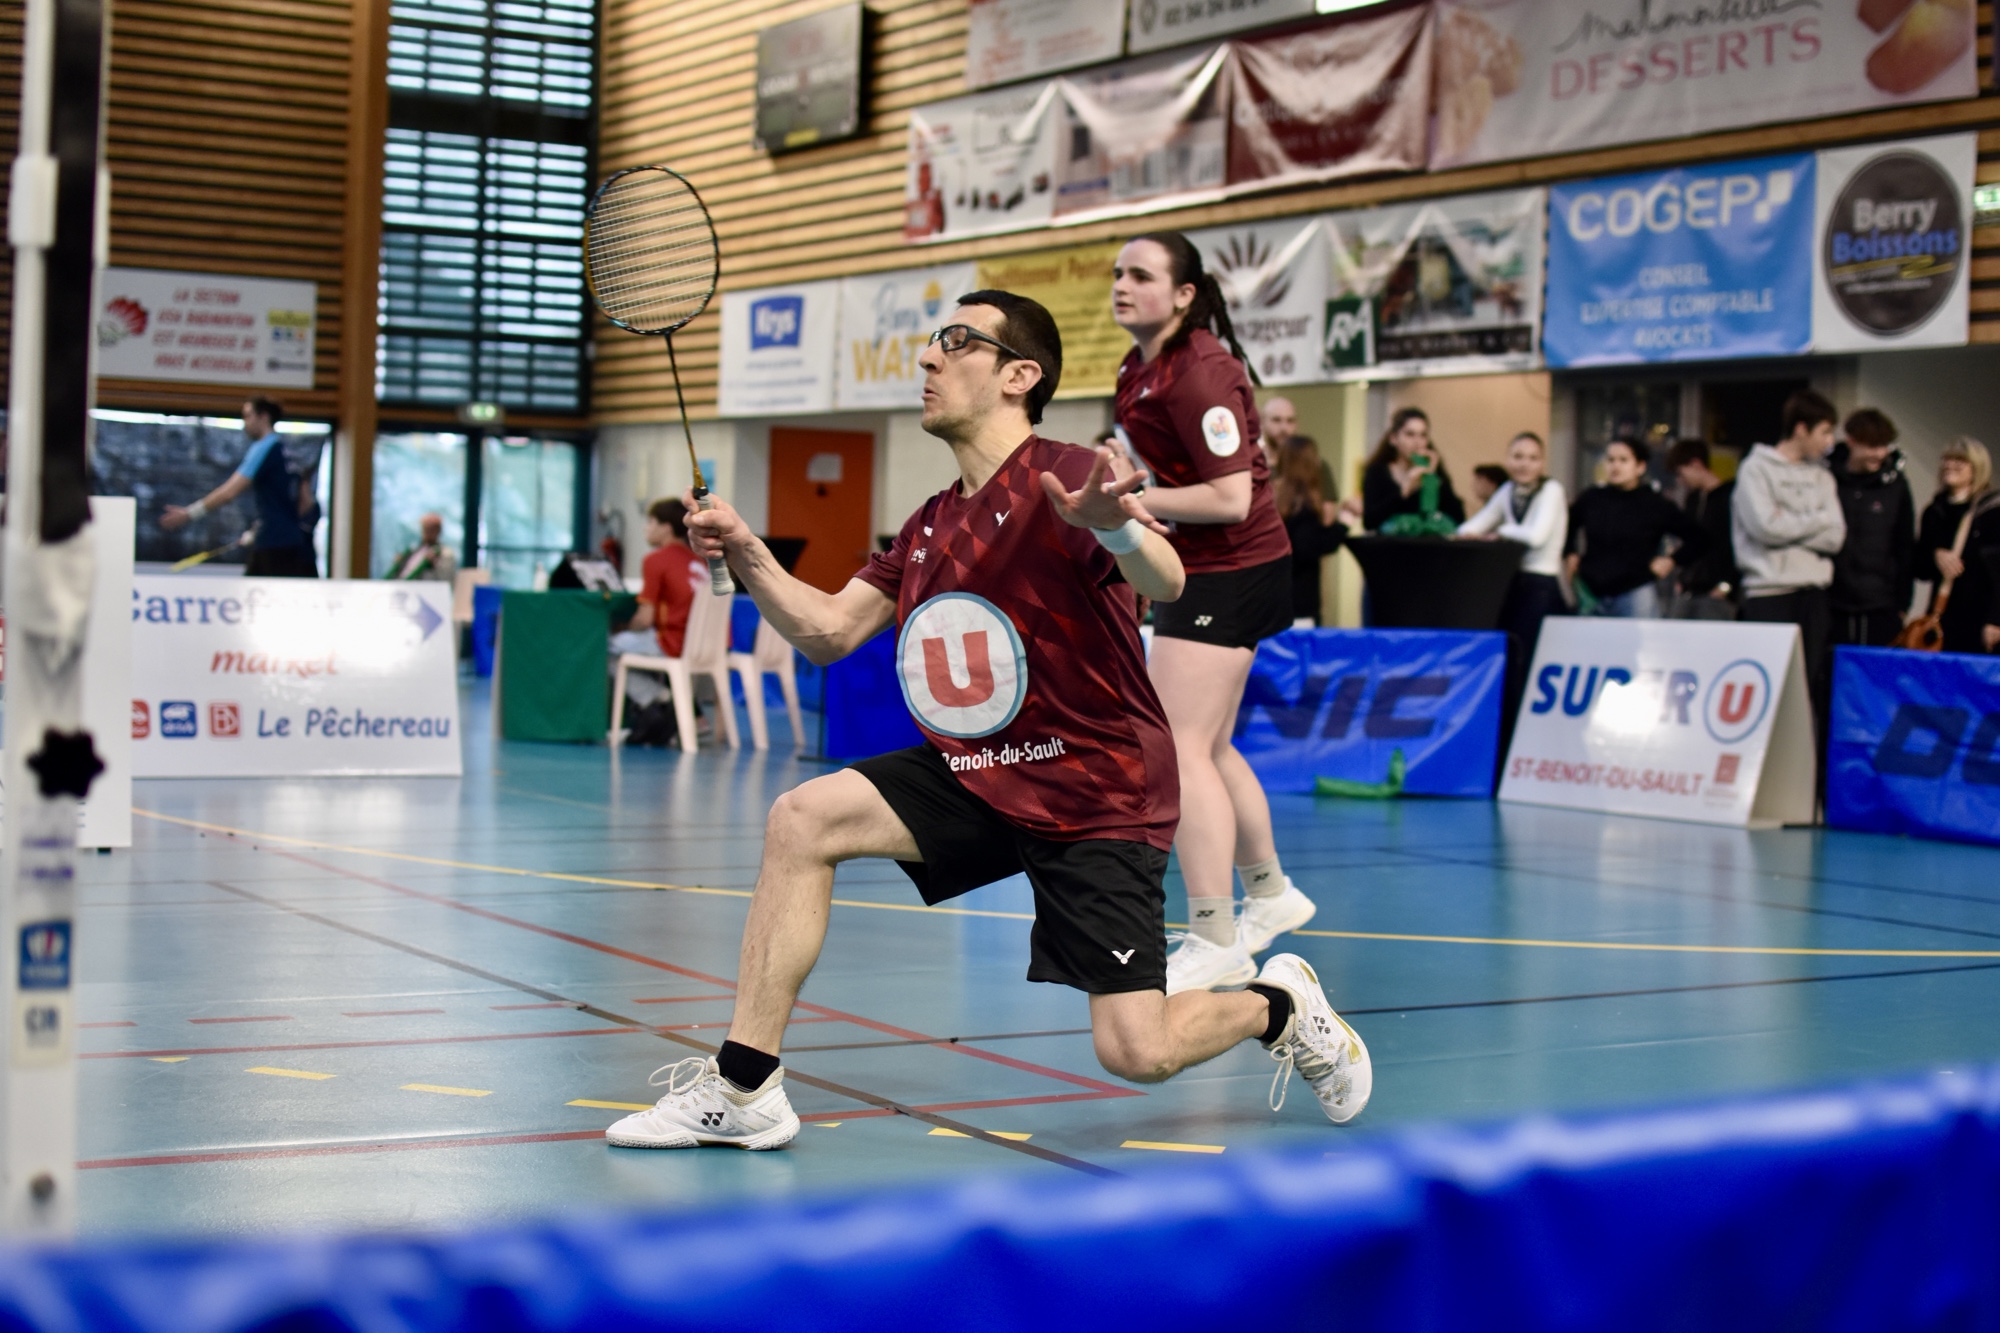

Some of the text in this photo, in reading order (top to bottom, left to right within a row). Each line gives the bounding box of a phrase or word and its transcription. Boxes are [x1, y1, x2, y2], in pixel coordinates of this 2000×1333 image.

[1550, 17, 1822, 101] DESSERTS
[1568, 174, 1761, 242] COGEP
[1853, 198, 1938, 235] Berry
[1832, 228, 1958, 264] Boissons
[755, 305, 797, 343] Krys
[921, 630, 995, 708] U
[258, 707, 450, 739] Le Pêchereau
[1718, 683, 1755, 724] U
